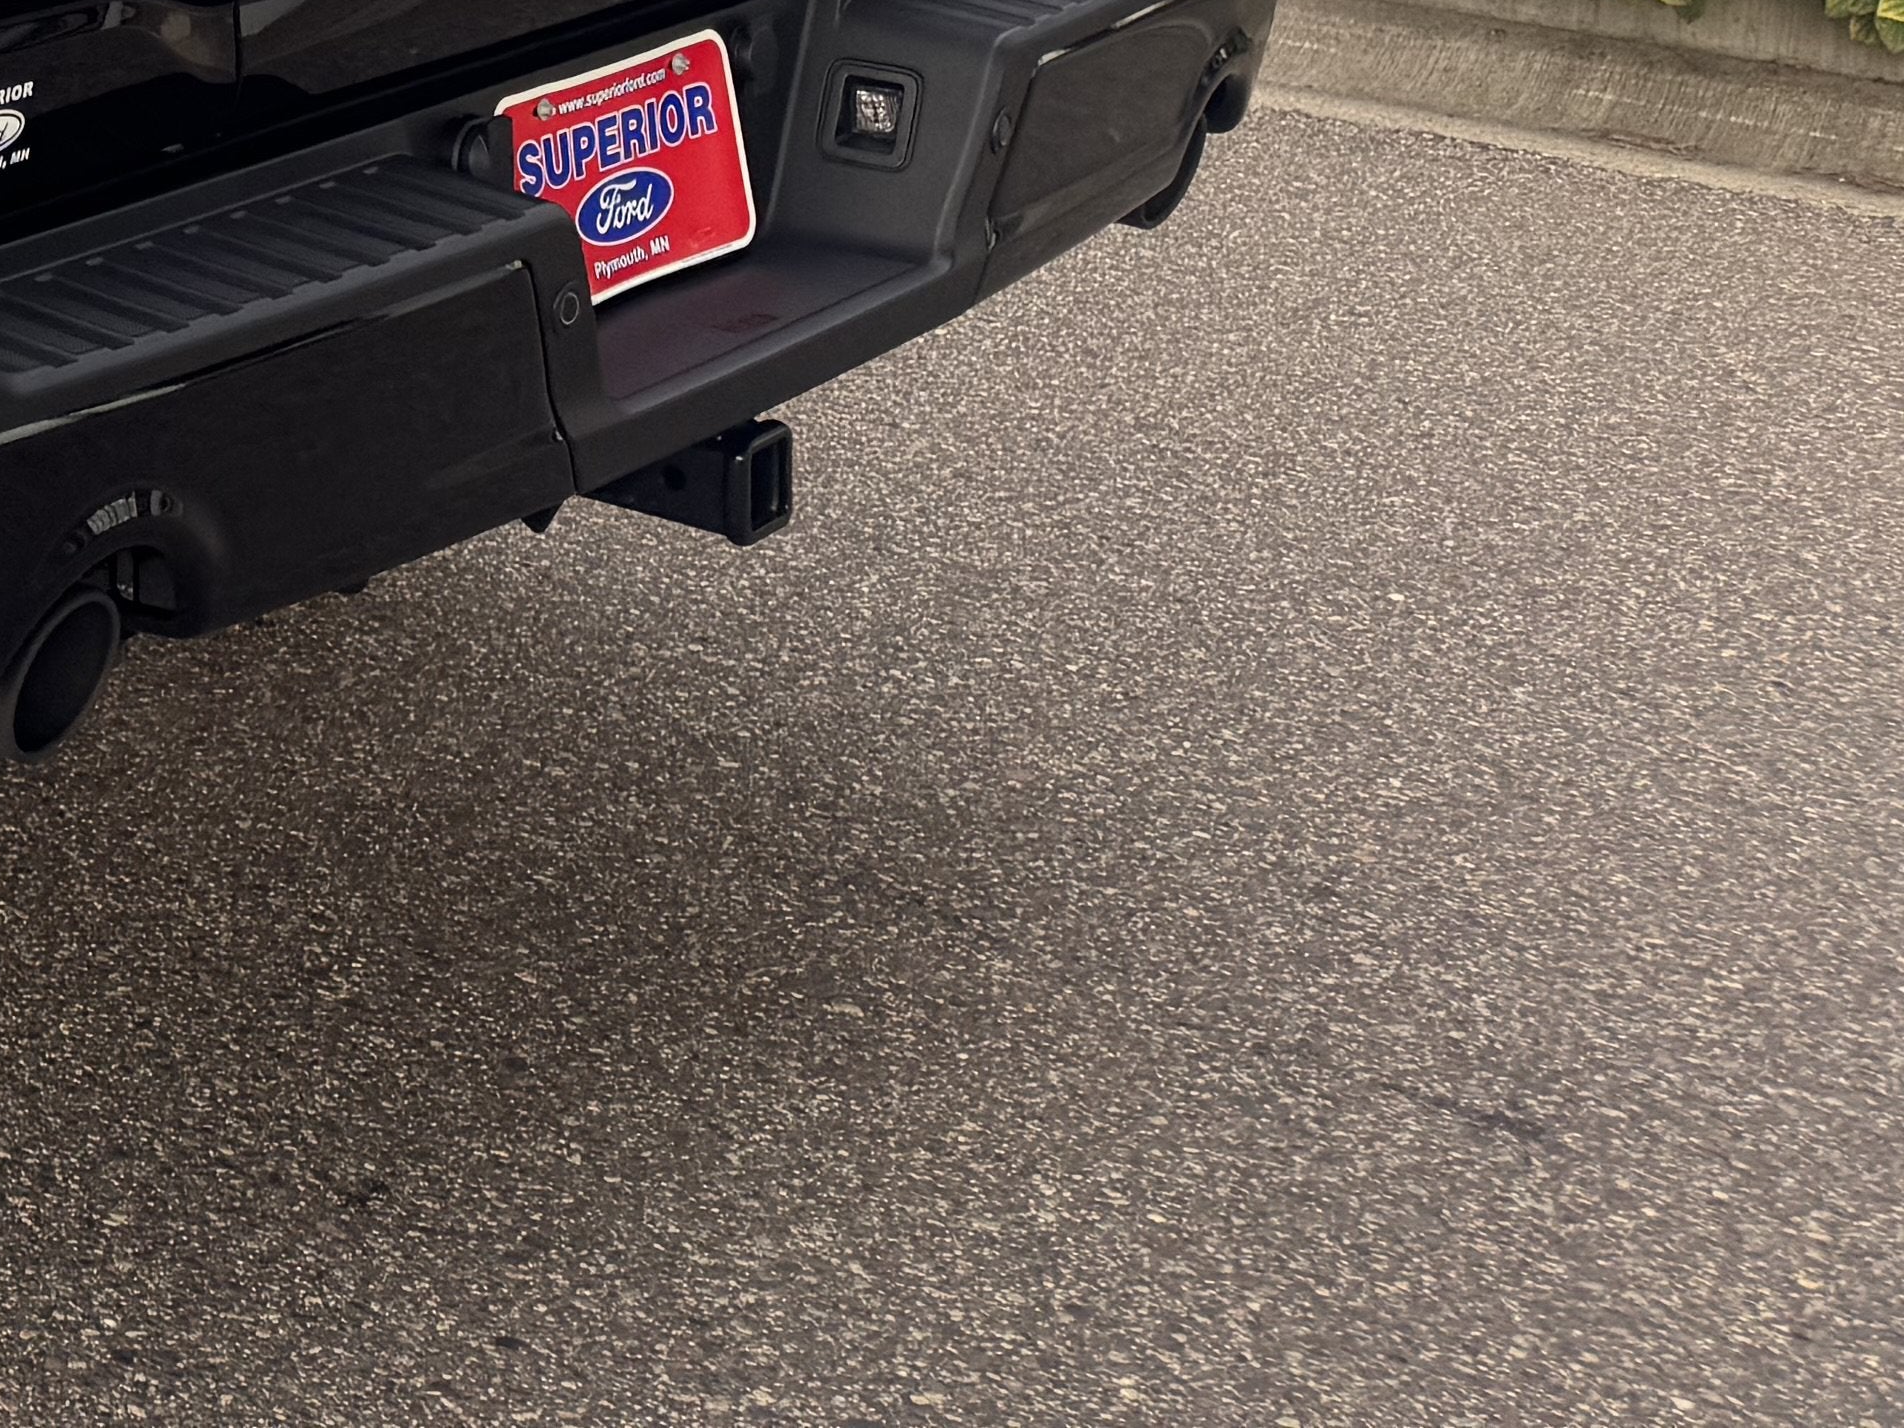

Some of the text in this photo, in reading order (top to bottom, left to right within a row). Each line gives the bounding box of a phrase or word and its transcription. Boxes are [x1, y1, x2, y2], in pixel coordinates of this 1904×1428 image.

[557, 68, 666, 115] www.superiorford.com
[10, 147, 30, 165] MN
[517, 82, 718, 197] SUPERIOR
[596, 178, 656, 235] Ford
[594, 247, 649, 280] Plymouth,
[650, 235, 670, 257] MN
